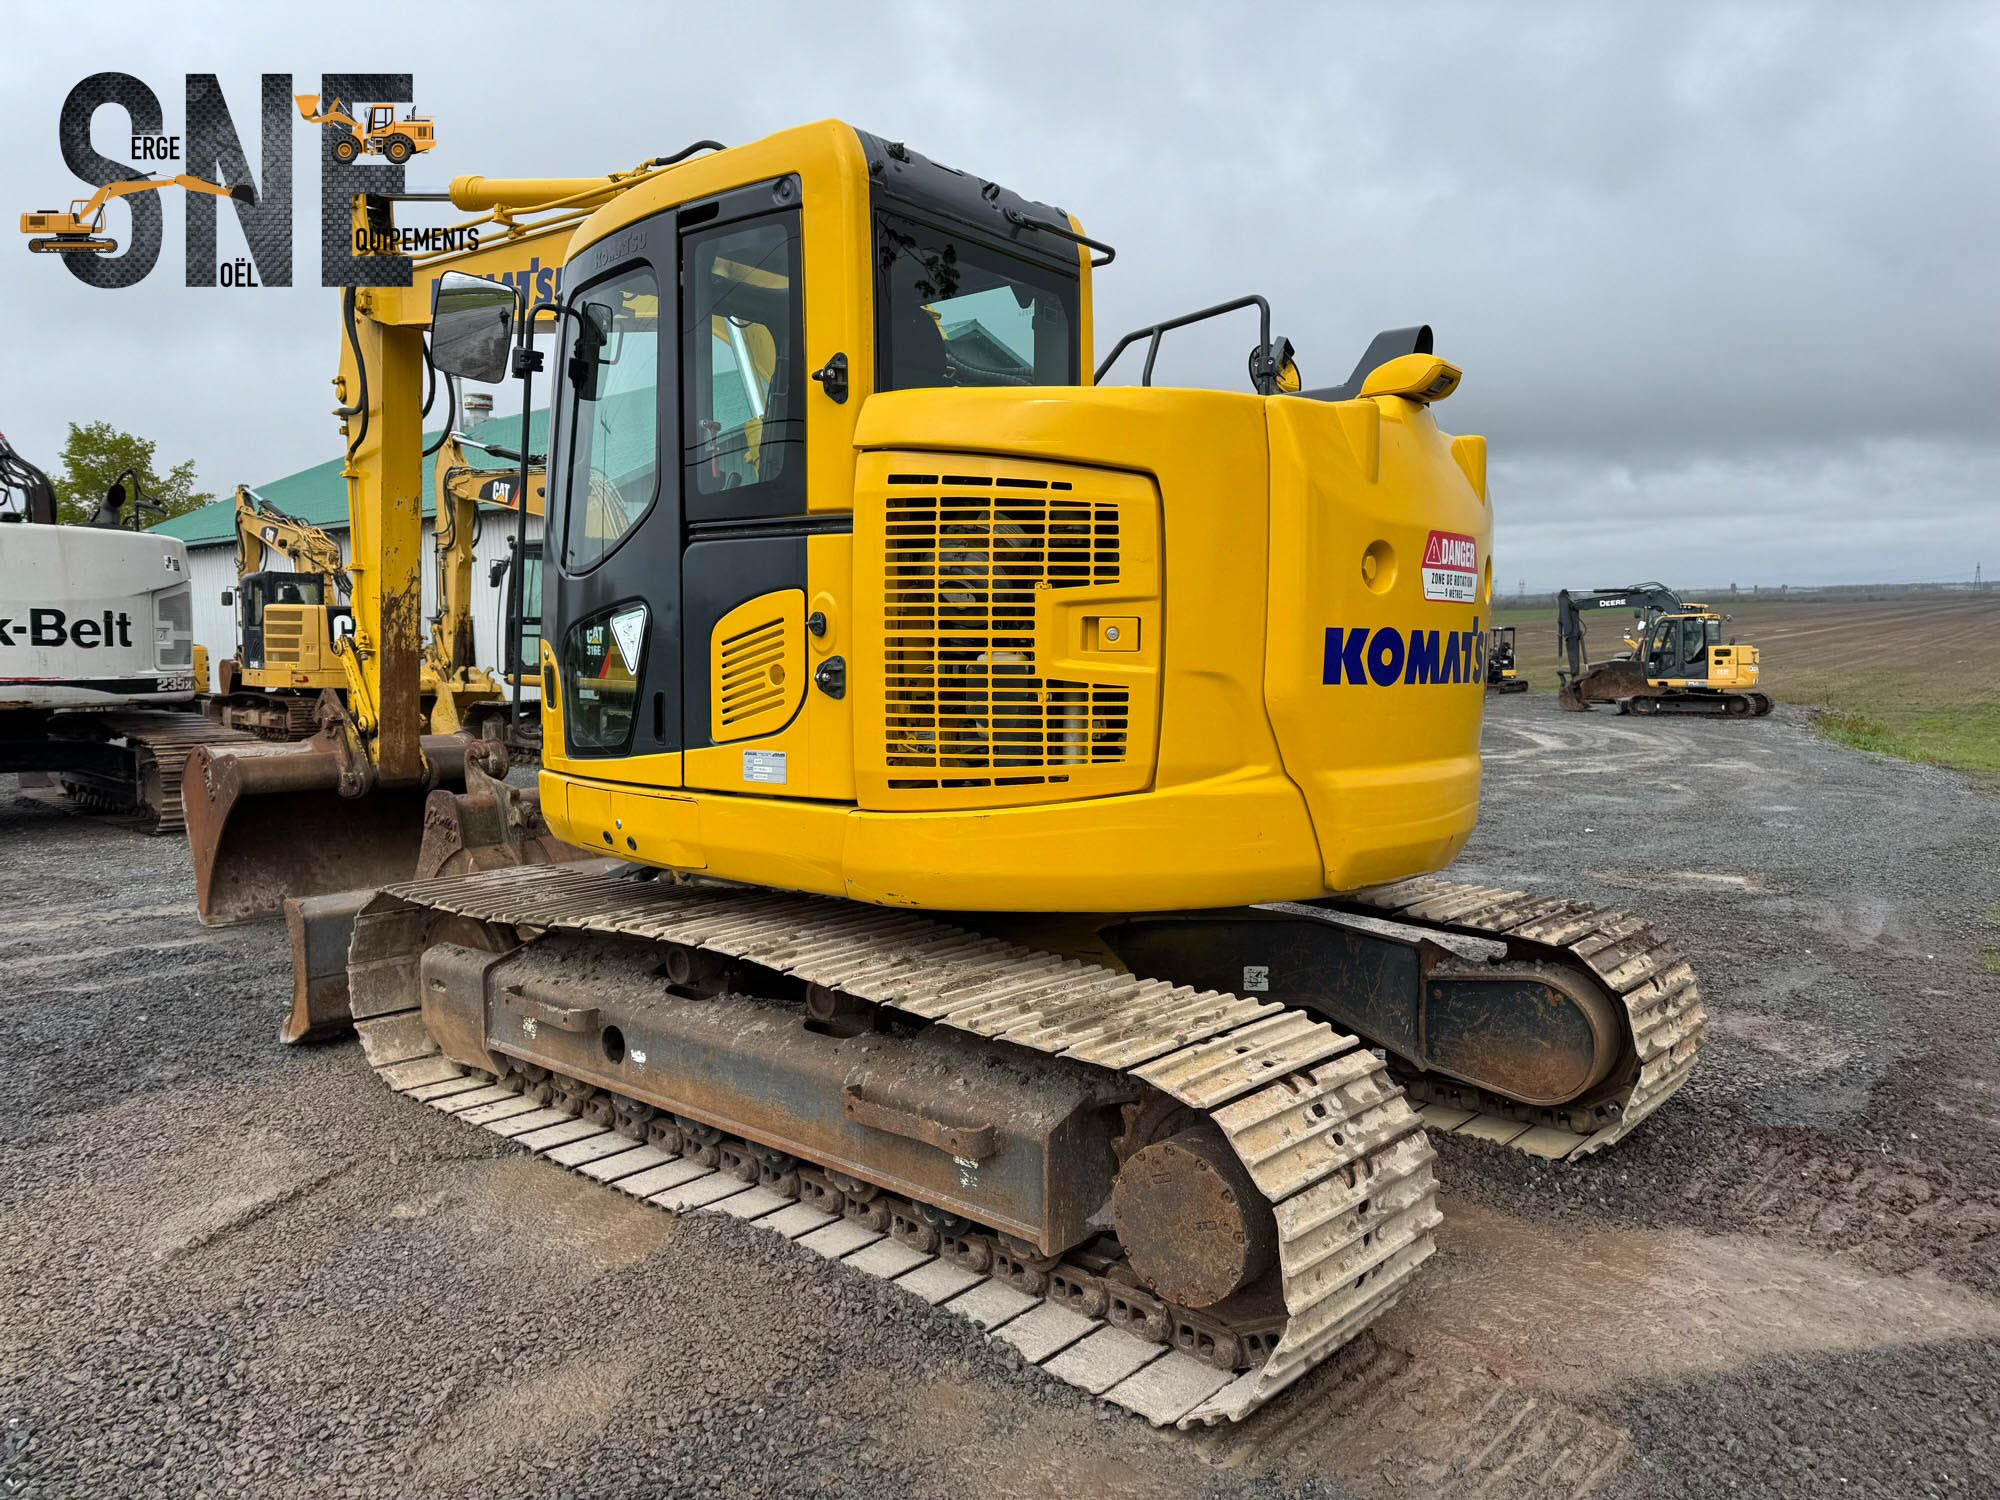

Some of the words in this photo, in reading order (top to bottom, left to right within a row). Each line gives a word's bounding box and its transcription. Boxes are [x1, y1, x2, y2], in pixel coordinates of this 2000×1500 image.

[492, 481, 511, 503] CAT
[1441, 537, 1475, 569] DANGER
[1431, 572, 1445, 585] ZONE
[1446, 573, 1453, 586] DE
[1599, 598, 1626, 607] DEERE
[586, 625, 604, 644] CAT
